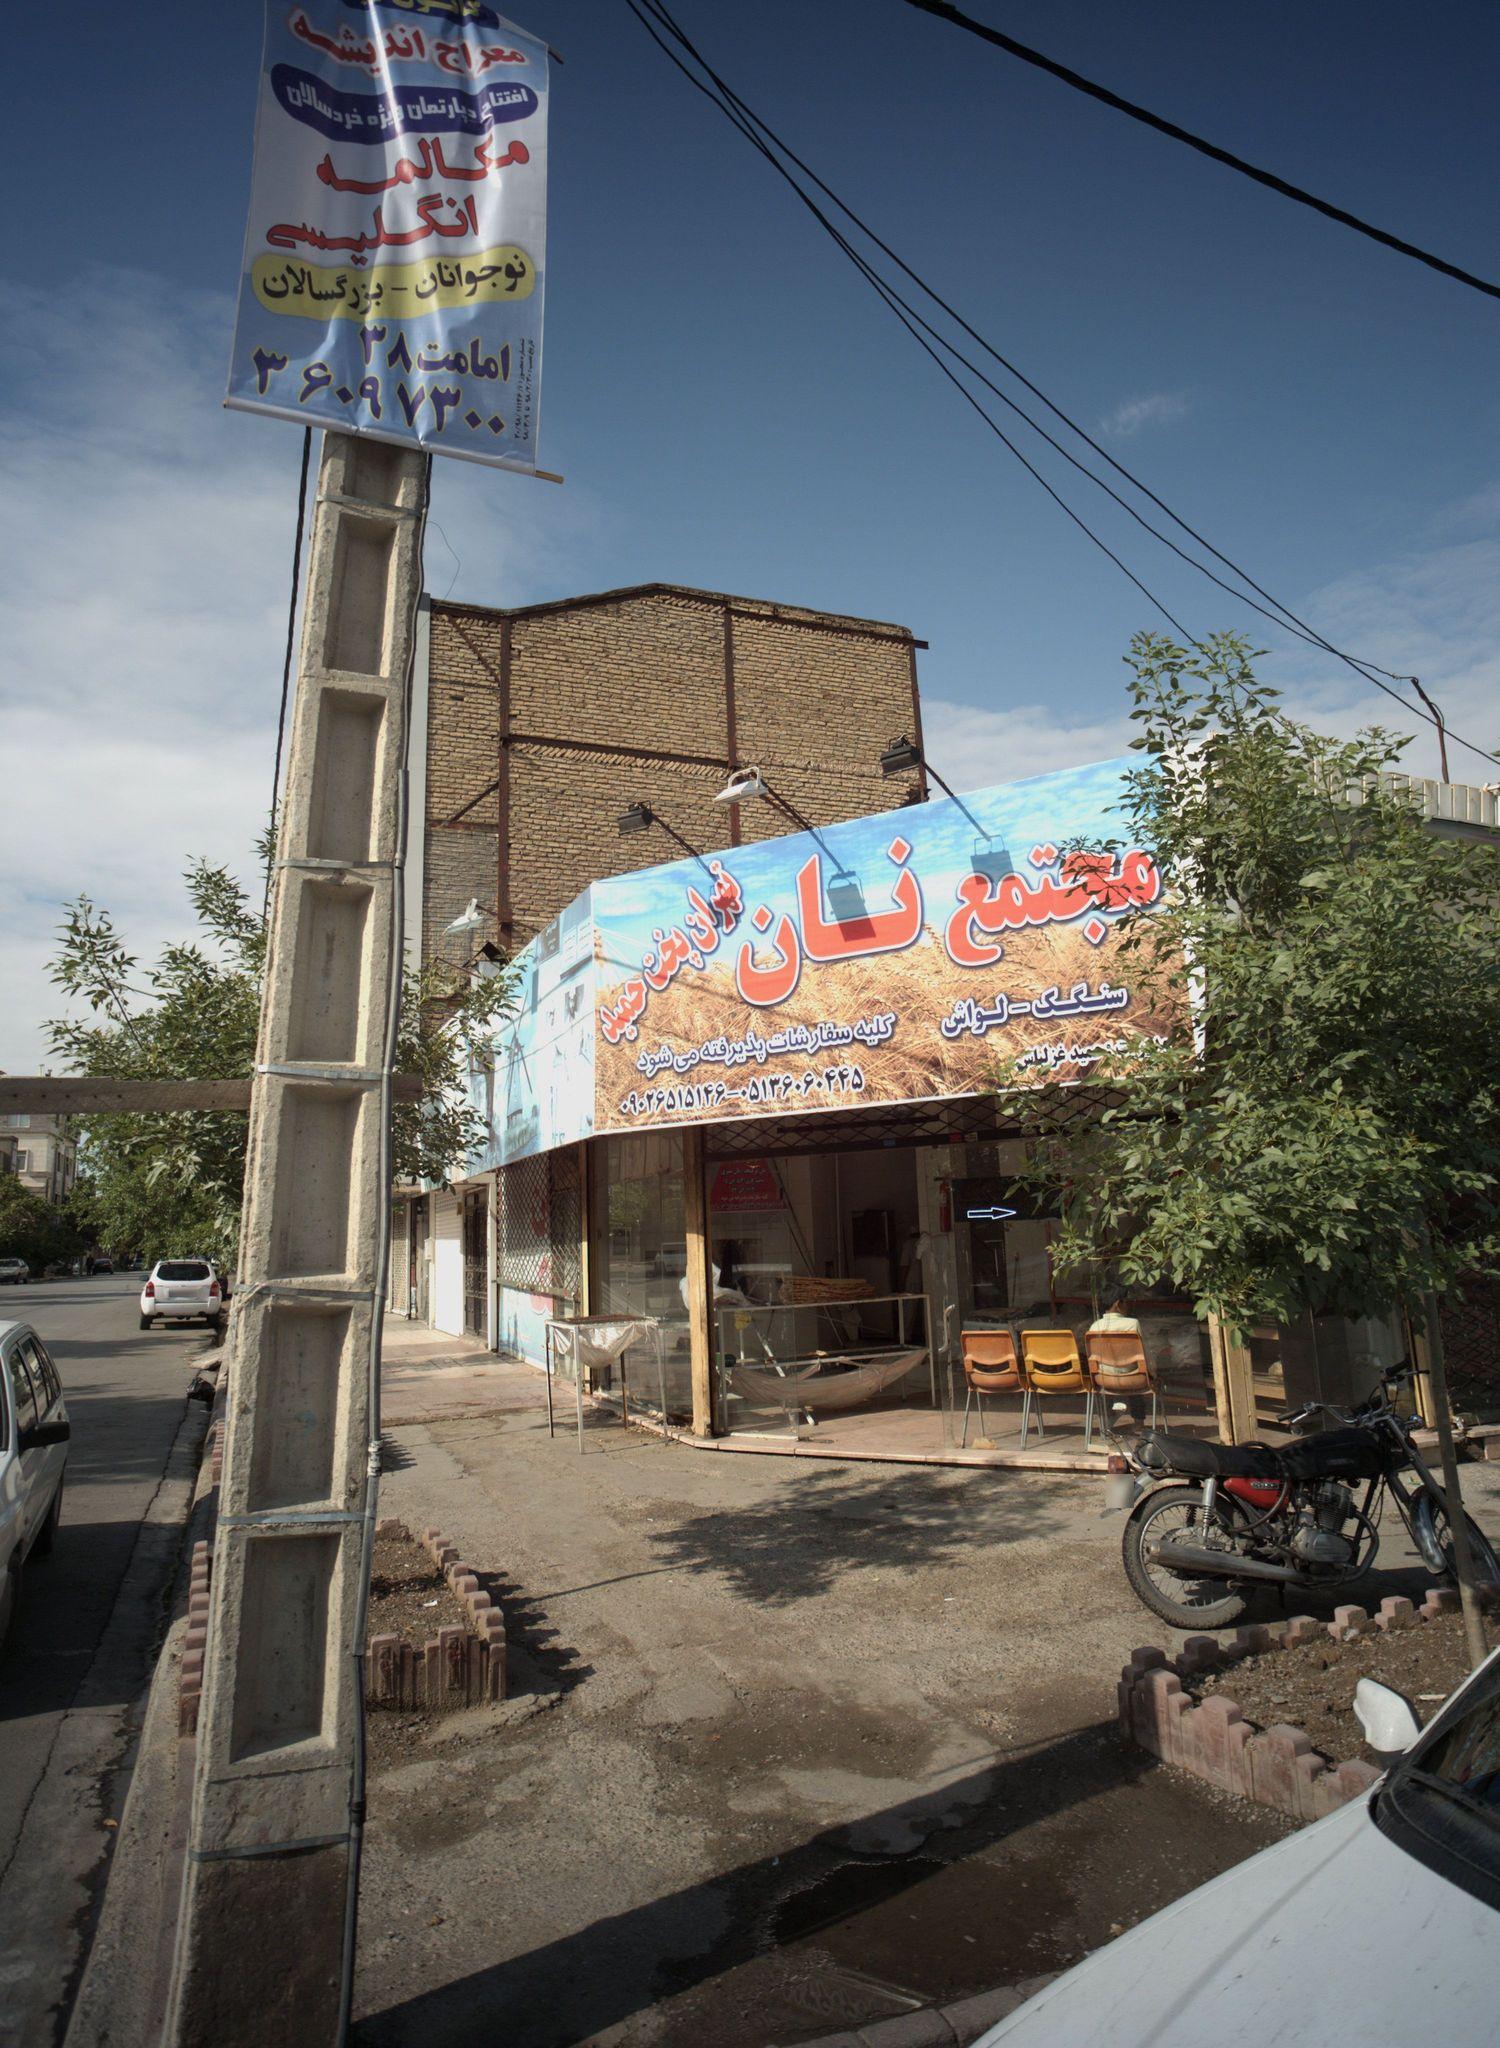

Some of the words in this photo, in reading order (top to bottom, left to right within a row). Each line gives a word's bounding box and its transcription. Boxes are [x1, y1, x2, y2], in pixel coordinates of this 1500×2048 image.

[294, 14, 425, 74] اندیشه
[434, 40, 527, 74] معراج
[286, 81, 364, 130] خردسالان
[408, 95, 477, 123] دپارتمان
[480, 87, 530, 123] افتتاح
[316, 136, 530, 195] مکالمه
[266, 194, 480, 265] انگلیسی
[262, 264, 384, 315] بزرگسالان
[416, 253, 527, 300] نوجوانان
[736, 836, 923, 1006] نان
[945, 841, 1160, 967] مجتمع
[642, 926, 705, 991] پخت
[600, 978, 648, 1043] حمید
[853, 1013, 896, 1047] کلیه
[701, 1031, 767, 1066] پذیرفته
[767, 1020, 853, 1054] سفارشات
